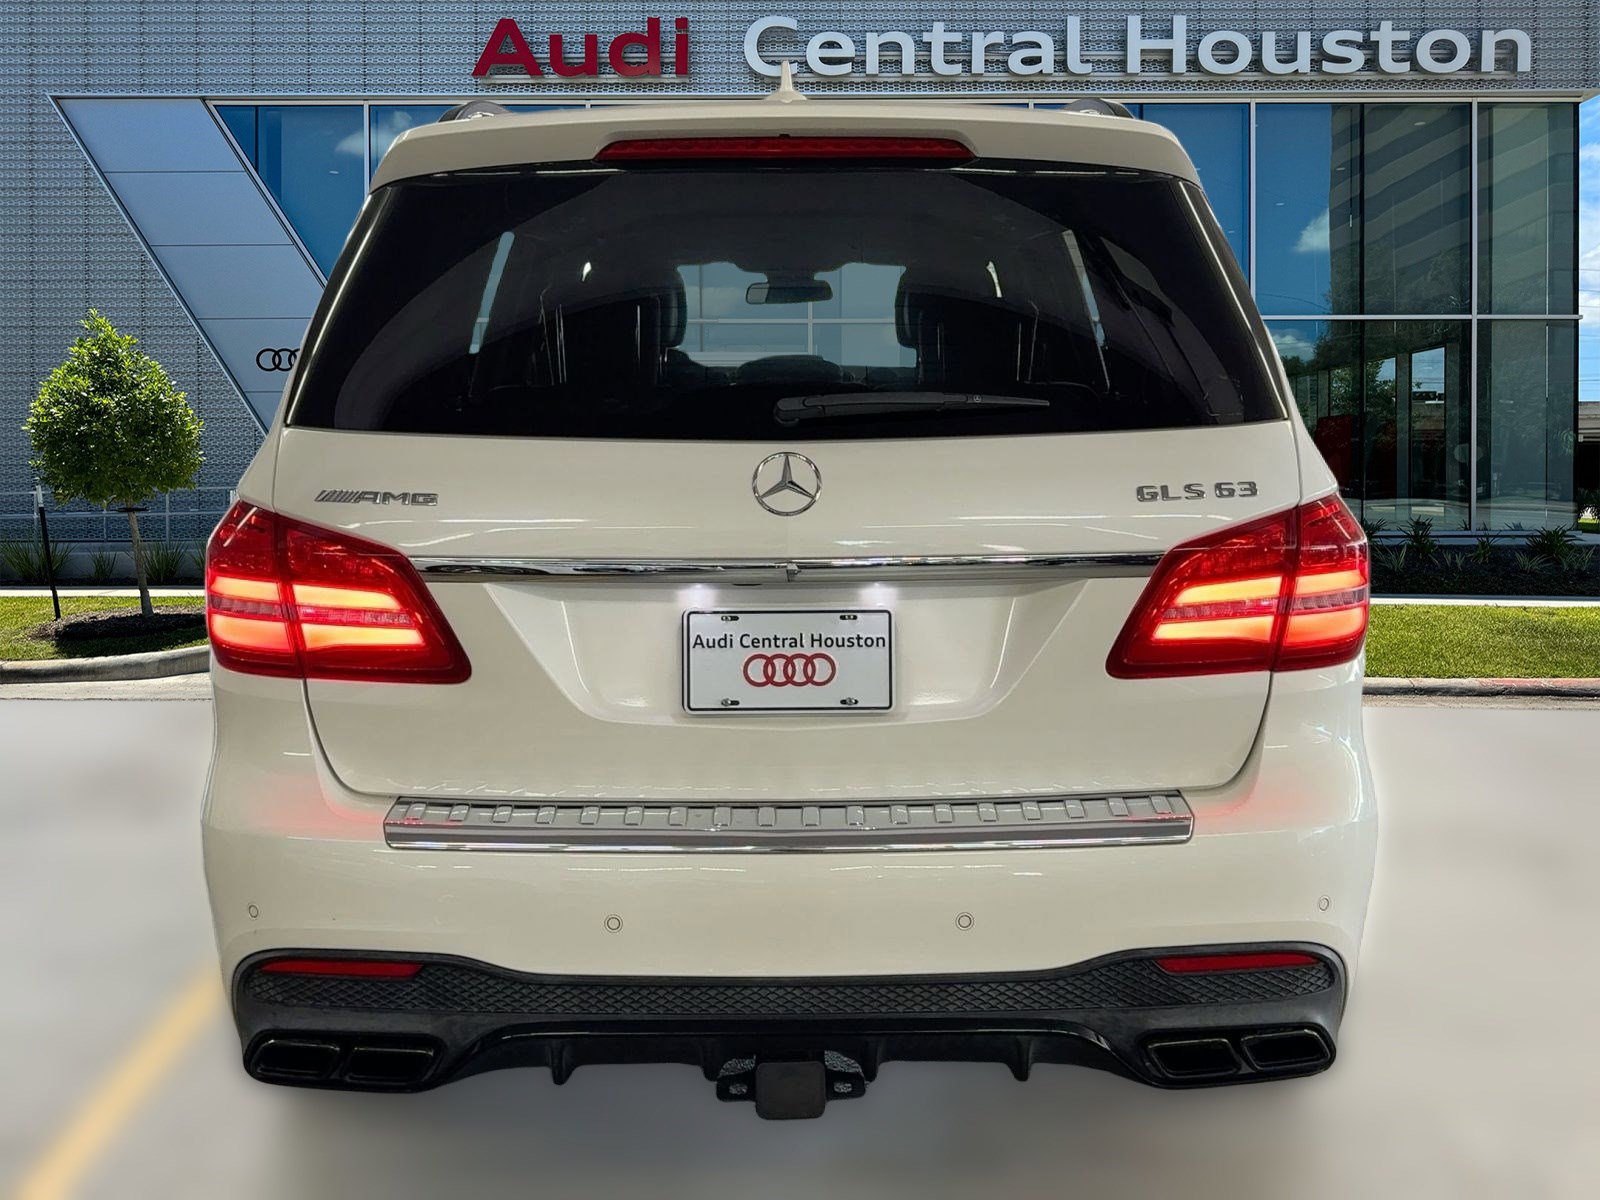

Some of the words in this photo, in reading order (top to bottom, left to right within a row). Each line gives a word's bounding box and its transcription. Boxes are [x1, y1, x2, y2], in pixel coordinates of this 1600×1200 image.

[472, 17, 690, 77] Audi
[744, 15, 1092, 77] Central
[1127, 15, 1533, 74] Houston
[355, 491, 439, 506] AMG
[1136, 483, 1206, 502] GLS
[1214, 481, 1258, 499] 63
[692, 633, 733, 649] Audi
[739, 633, 804, 649] Central
[810, 633, 886, 648] Houston
